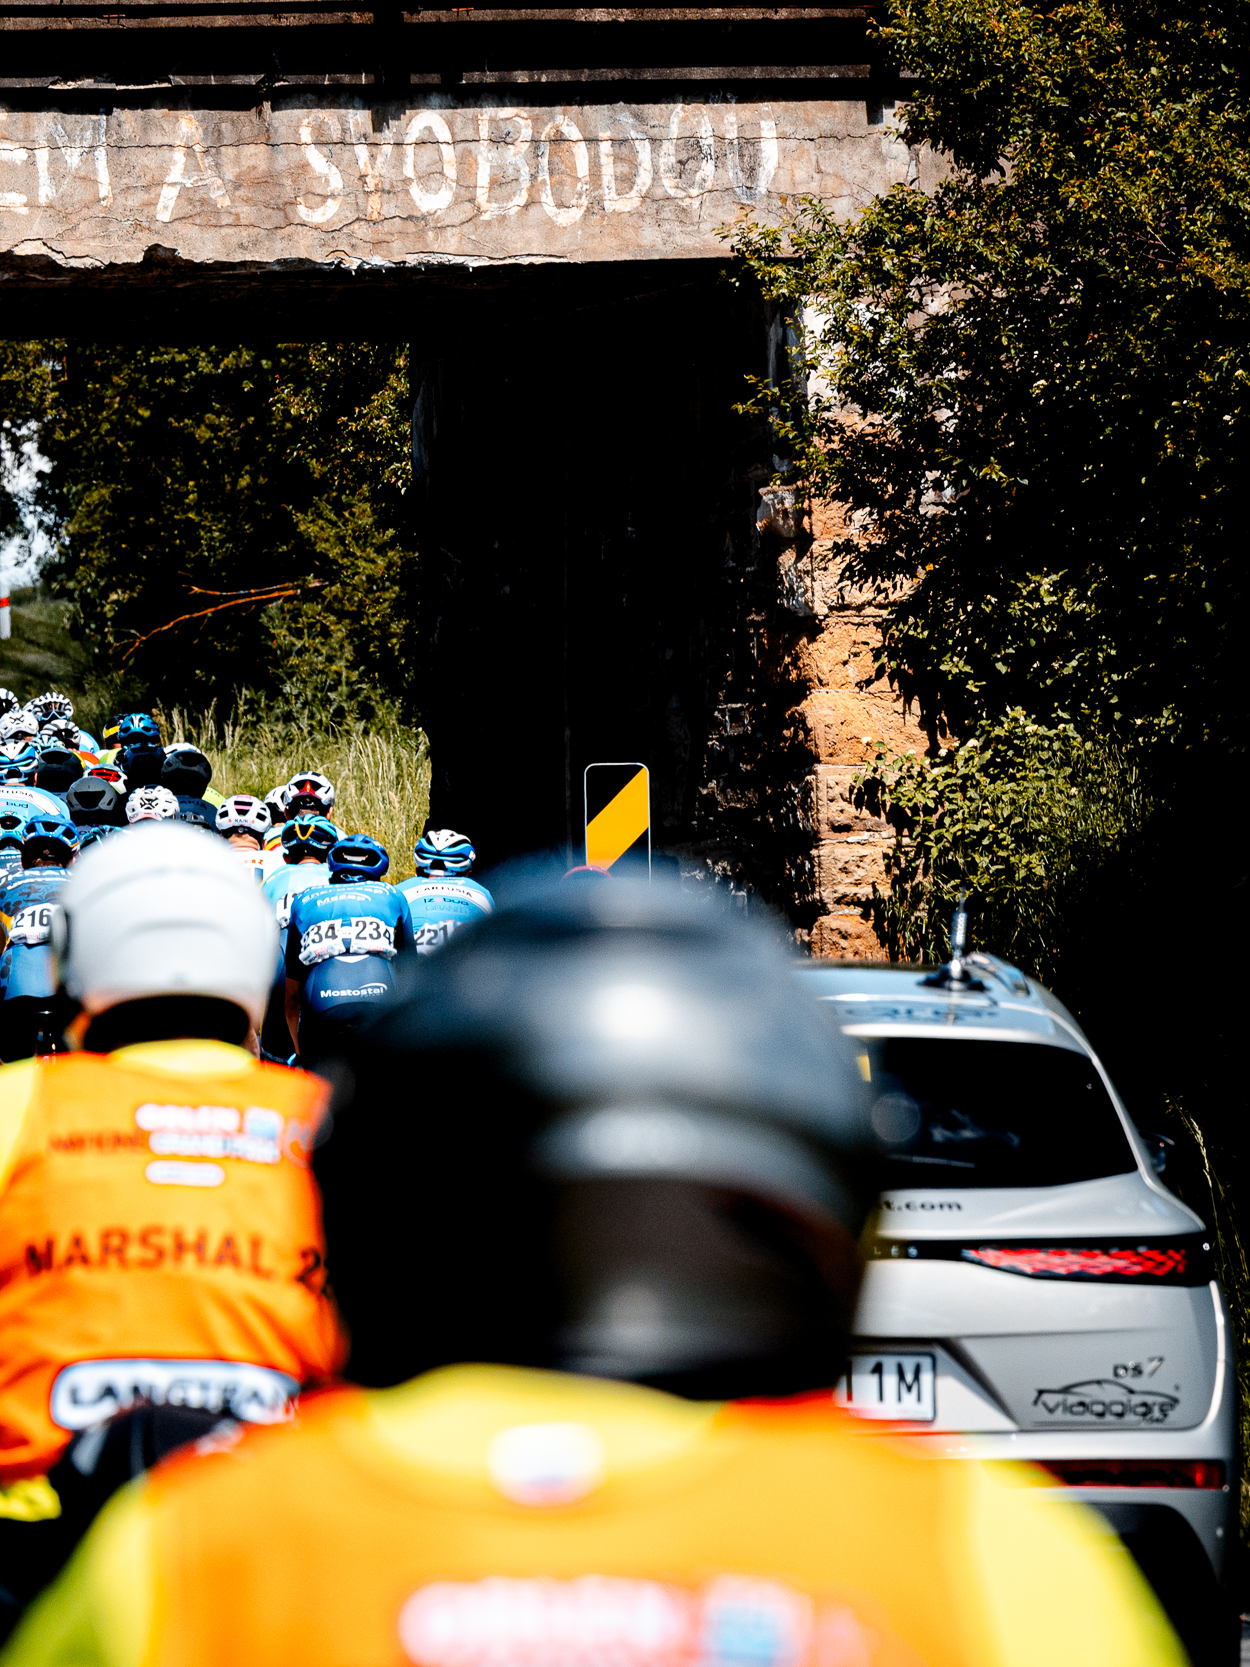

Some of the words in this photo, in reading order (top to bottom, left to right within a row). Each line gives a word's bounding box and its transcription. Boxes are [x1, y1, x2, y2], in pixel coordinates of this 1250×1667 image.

[155, 112, 232, 223] A
[294, 103, 779, 228] SVOBODOU
[15, 908, 50, 928] 216
[355, 920, 392, 945] 234
[414, 924, 449, 946] 221
[320, 986, 385, 998] Mostostal
[24, 1224, 276, 1280] MARSHAL
